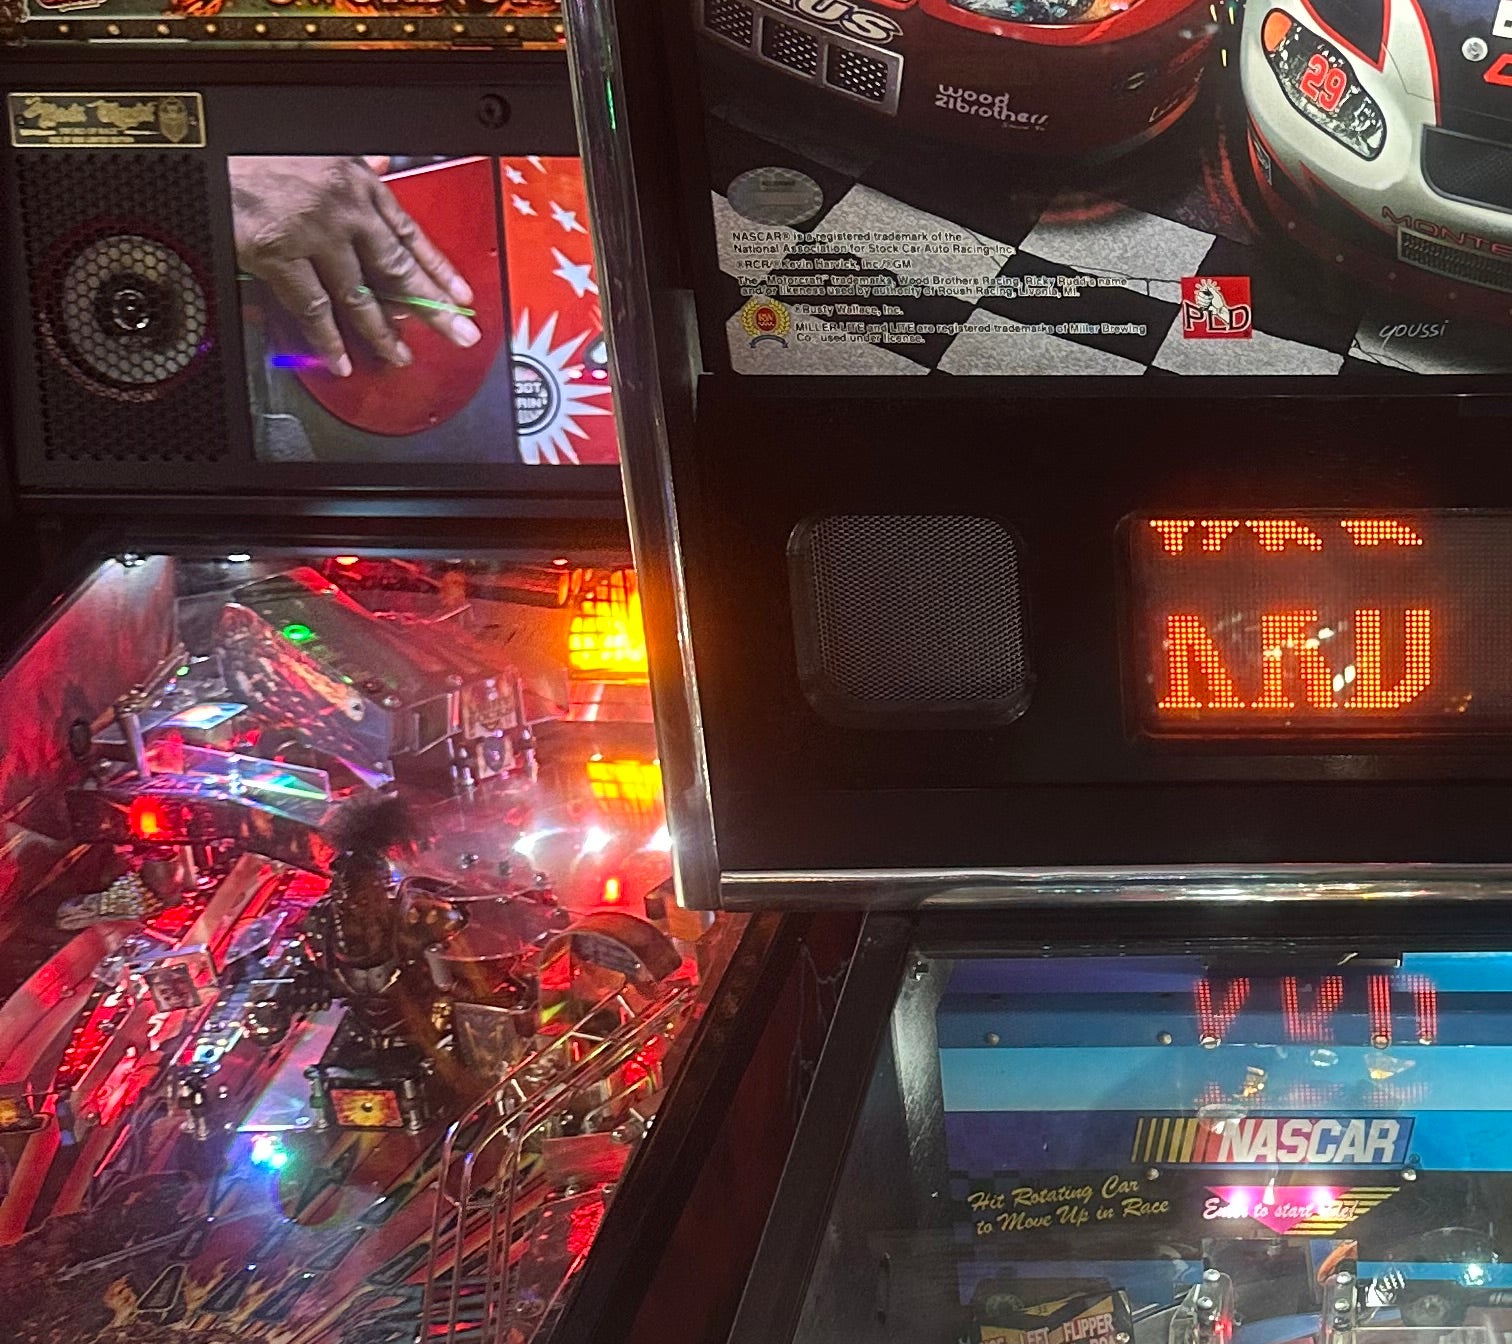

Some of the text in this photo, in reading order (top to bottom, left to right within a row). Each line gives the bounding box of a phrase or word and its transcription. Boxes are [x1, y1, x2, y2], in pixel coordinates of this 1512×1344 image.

[938, 84, 1010, 107] wood
[1301, 56, 1346, 112] 29
[869, 244, 950, 254] Stock Car Auto
[874, 231, 962, 242] trademark the
[936, 323, 1147, 335] registered Miller Brewing
[1184, 302, 1251, 332] PLD
[821, 333, 882, 343] used under
[1217, 1118, 1401, 1164] NASCAR
[968, 1173, 1140, 1214] Hit Rotating Car
[976, 1194, 1170, 1236] to Move Up in Race
[1254, 1203, 1269, 1218] to
[1274, 1205, 1313, 1218] start
[1063, 1313, 1114, 1342] FLIPPER
